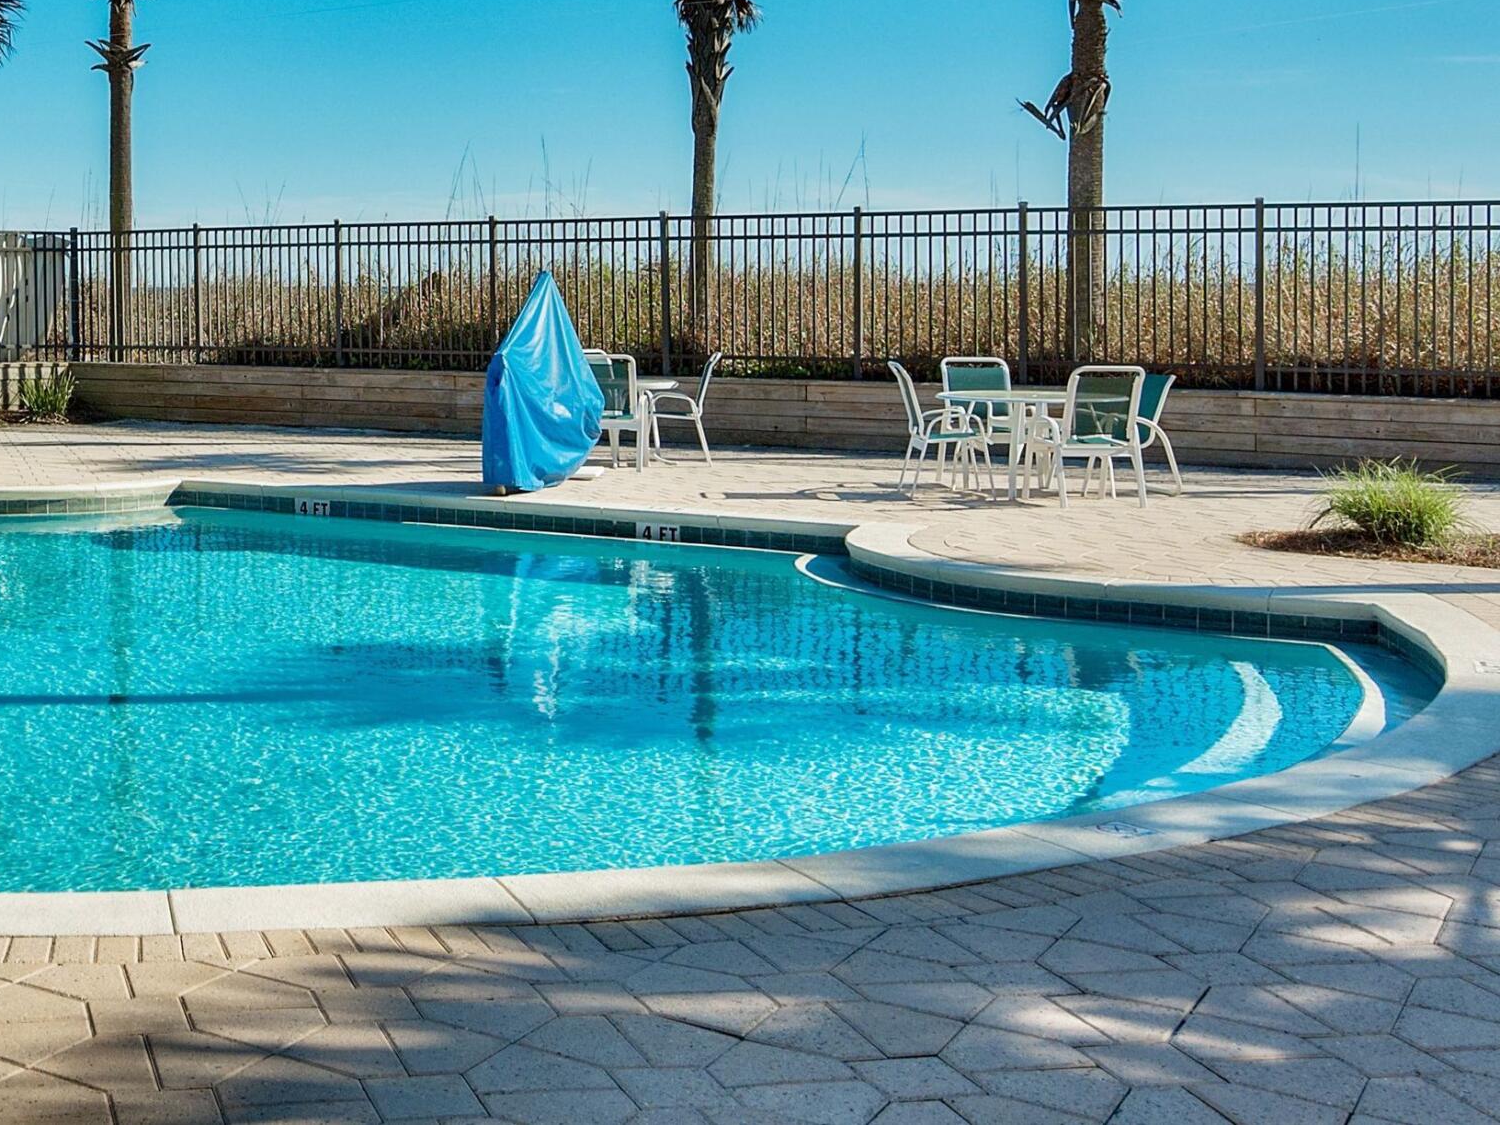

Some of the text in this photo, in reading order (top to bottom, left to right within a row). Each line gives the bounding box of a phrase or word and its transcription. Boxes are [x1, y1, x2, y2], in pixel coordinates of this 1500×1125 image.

[300, 501, 328, 515] 4 FT
[643, 525, 677, 542] 4 FT
